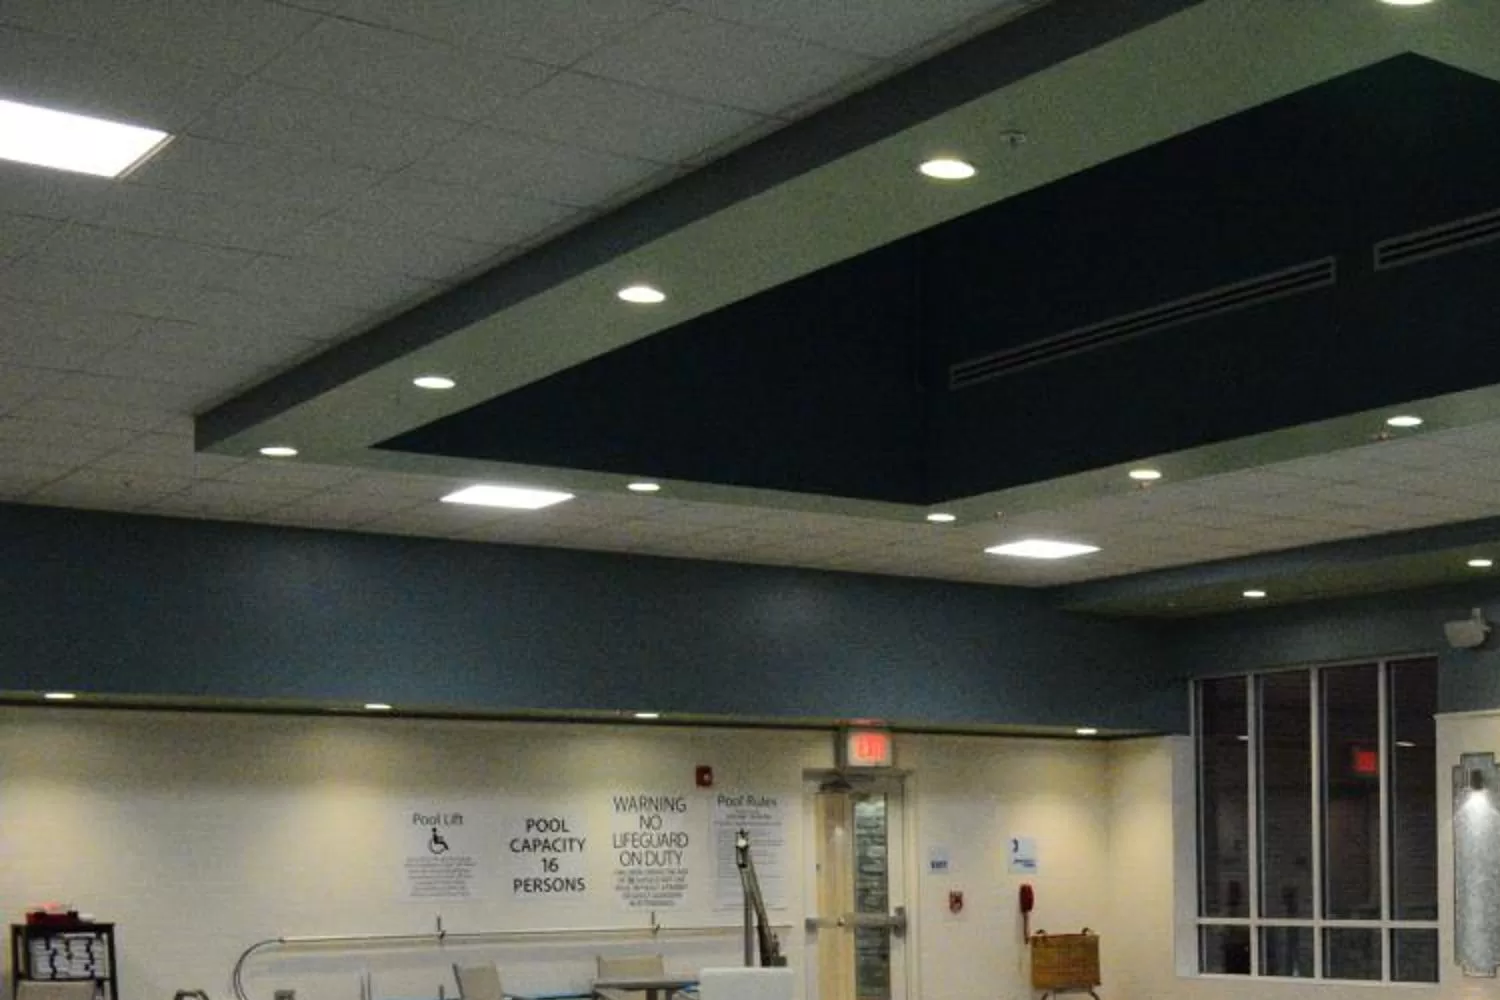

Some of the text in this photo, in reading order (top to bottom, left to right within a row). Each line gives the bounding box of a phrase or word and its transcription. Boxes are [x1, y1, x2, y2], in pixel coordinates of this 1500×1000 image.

[613, 795, 688, 812] WARNING
[412, 812, 441, 826] Pool
[526, 817, 570, 833] POOL
[640, 814, 663, 830] NO
[509, 837, 586, 853] CAPACITY
[612, 831, 689, 848] LIFEGUARD
[541, 857, 559, 872] 16
[620, 850, 683, 866] ON DUTY
[513, 877, 586, 893] PERSONS
